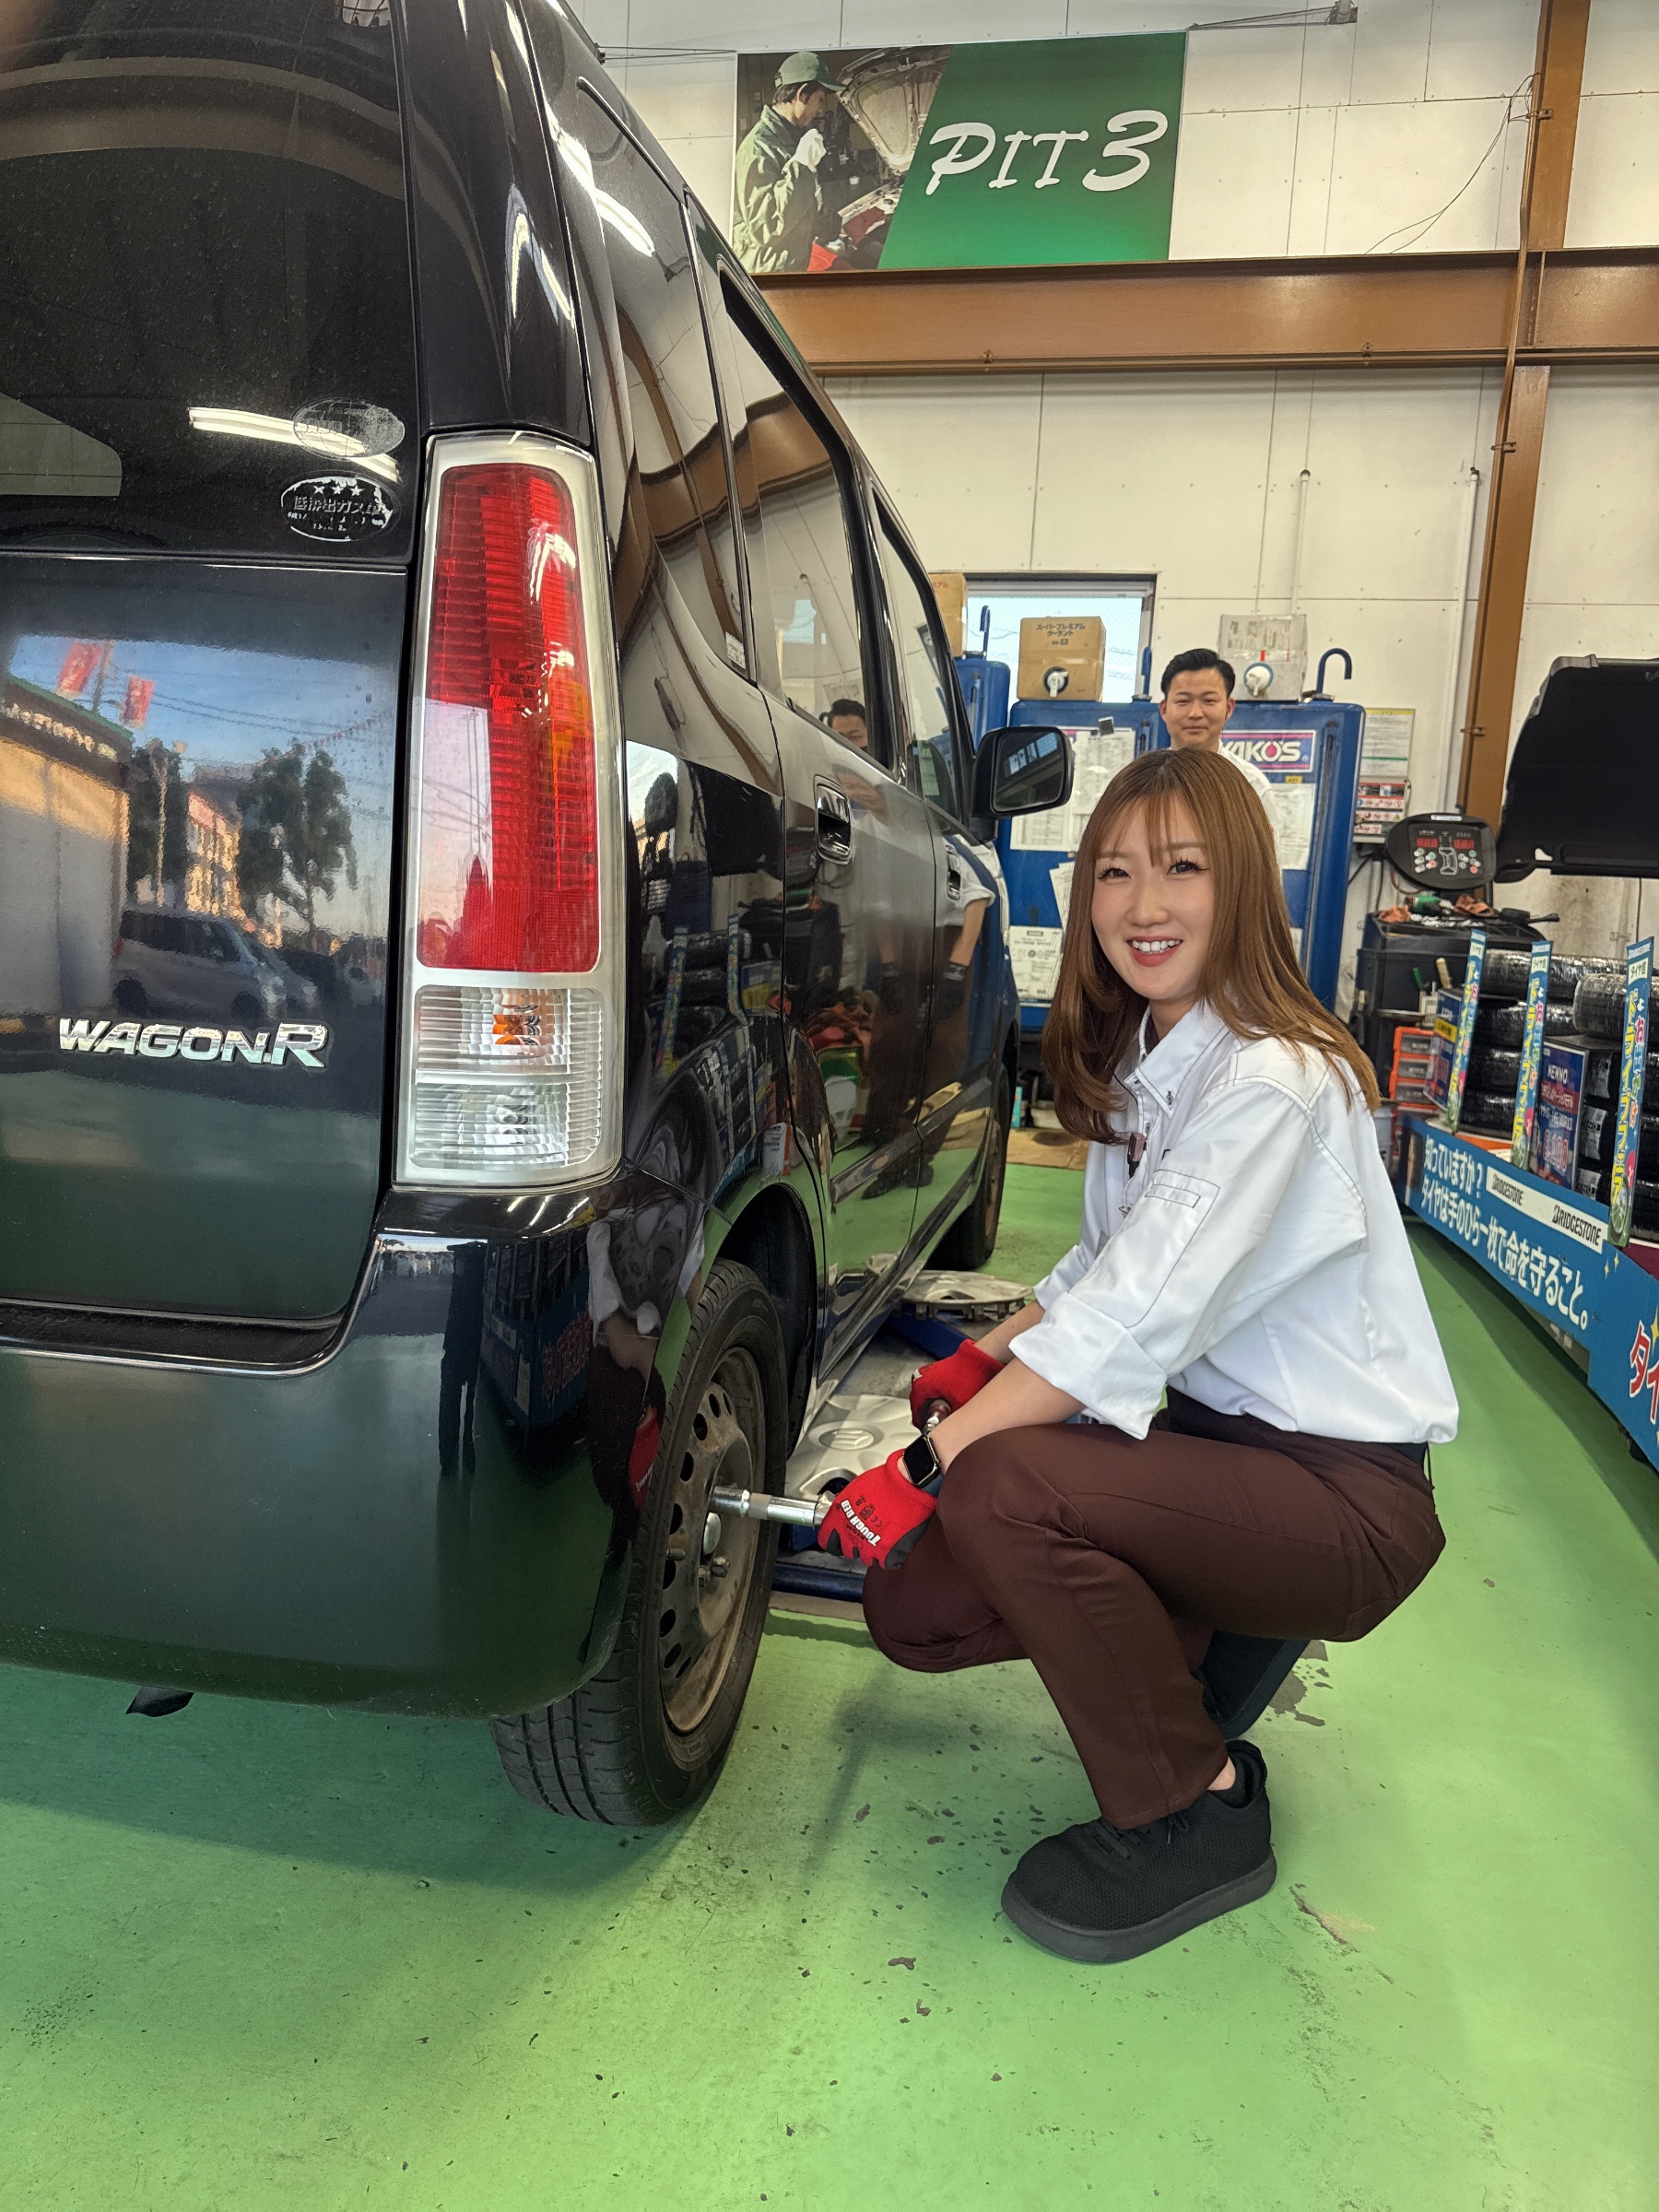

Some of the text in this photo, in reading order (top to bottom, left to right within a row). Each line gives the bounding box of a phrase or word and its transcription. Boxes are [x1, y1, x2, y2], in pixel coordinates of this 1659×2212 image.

[924, 109, 1168, 195] PIT 3
[1423, 1134, 1484, 1198] 知っていますか？
[1491, 1172, 1524, 1206] BRIDGESTONE
[1420, 1173, 1588, 1331] タイヤは手のひら一枚で命を守ること。
[1551, 1204, 1602, 1246] BRIDGESTONE
